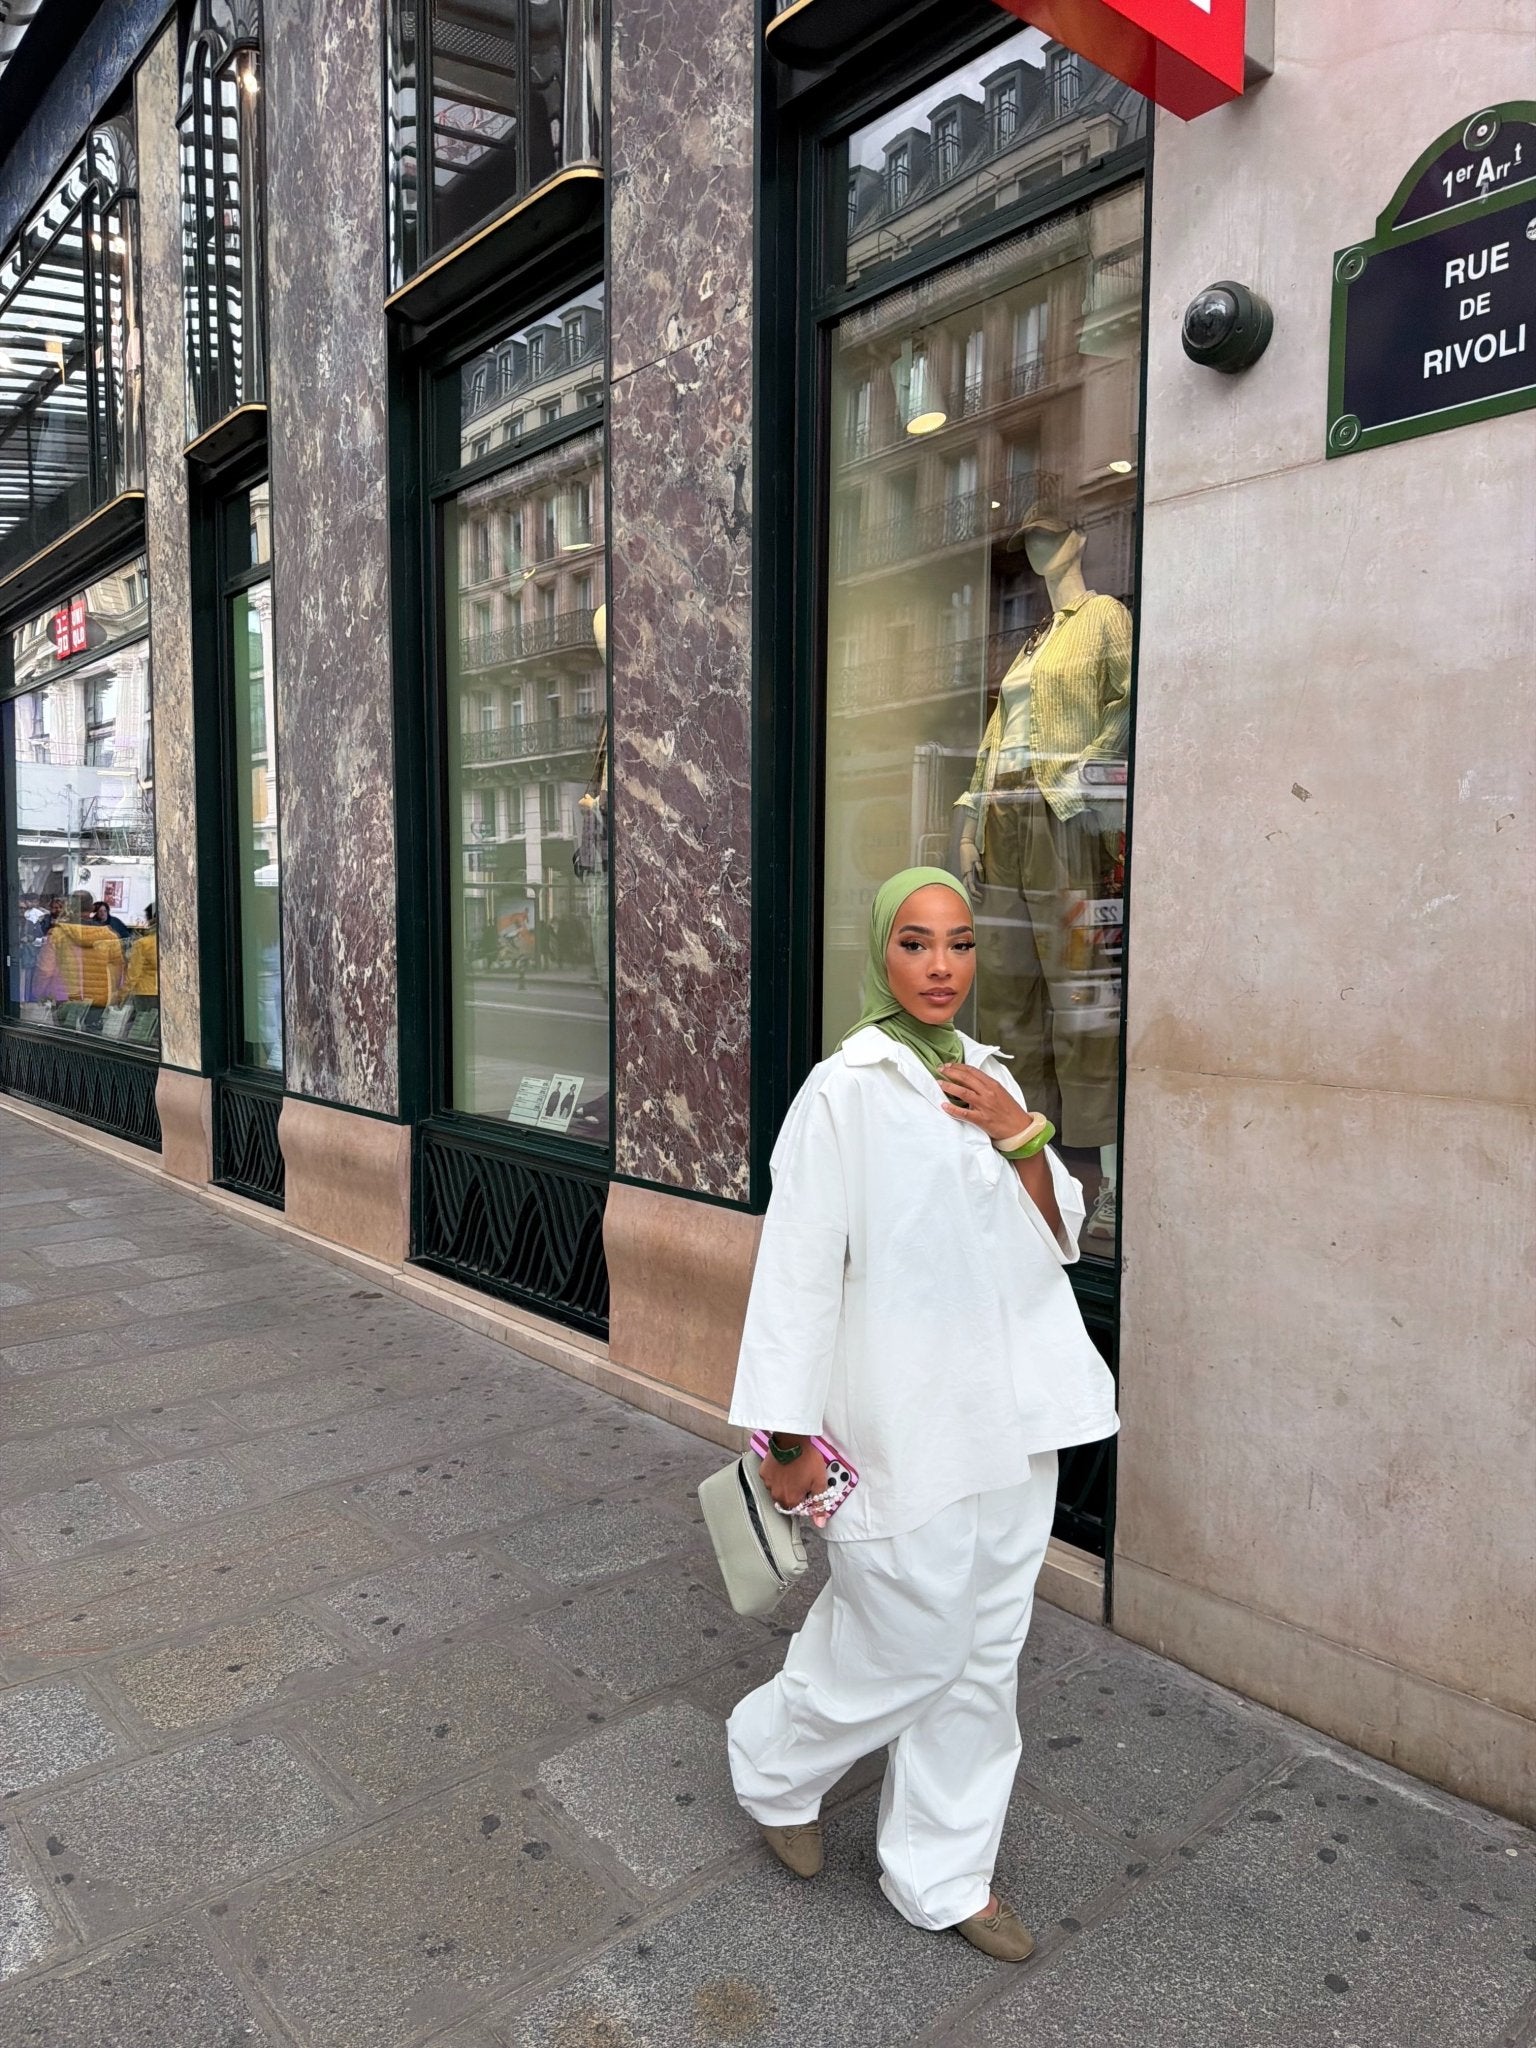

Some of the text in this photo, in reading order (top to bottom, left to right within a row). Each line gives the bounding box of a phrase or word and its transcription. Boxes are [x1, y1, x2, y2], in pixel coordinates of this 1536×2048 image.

[1445, 241, 1510, 289] RUE
[1459, 292, 1491, 321] DE
[1423, 323, 1526, 379] RIVOLI
